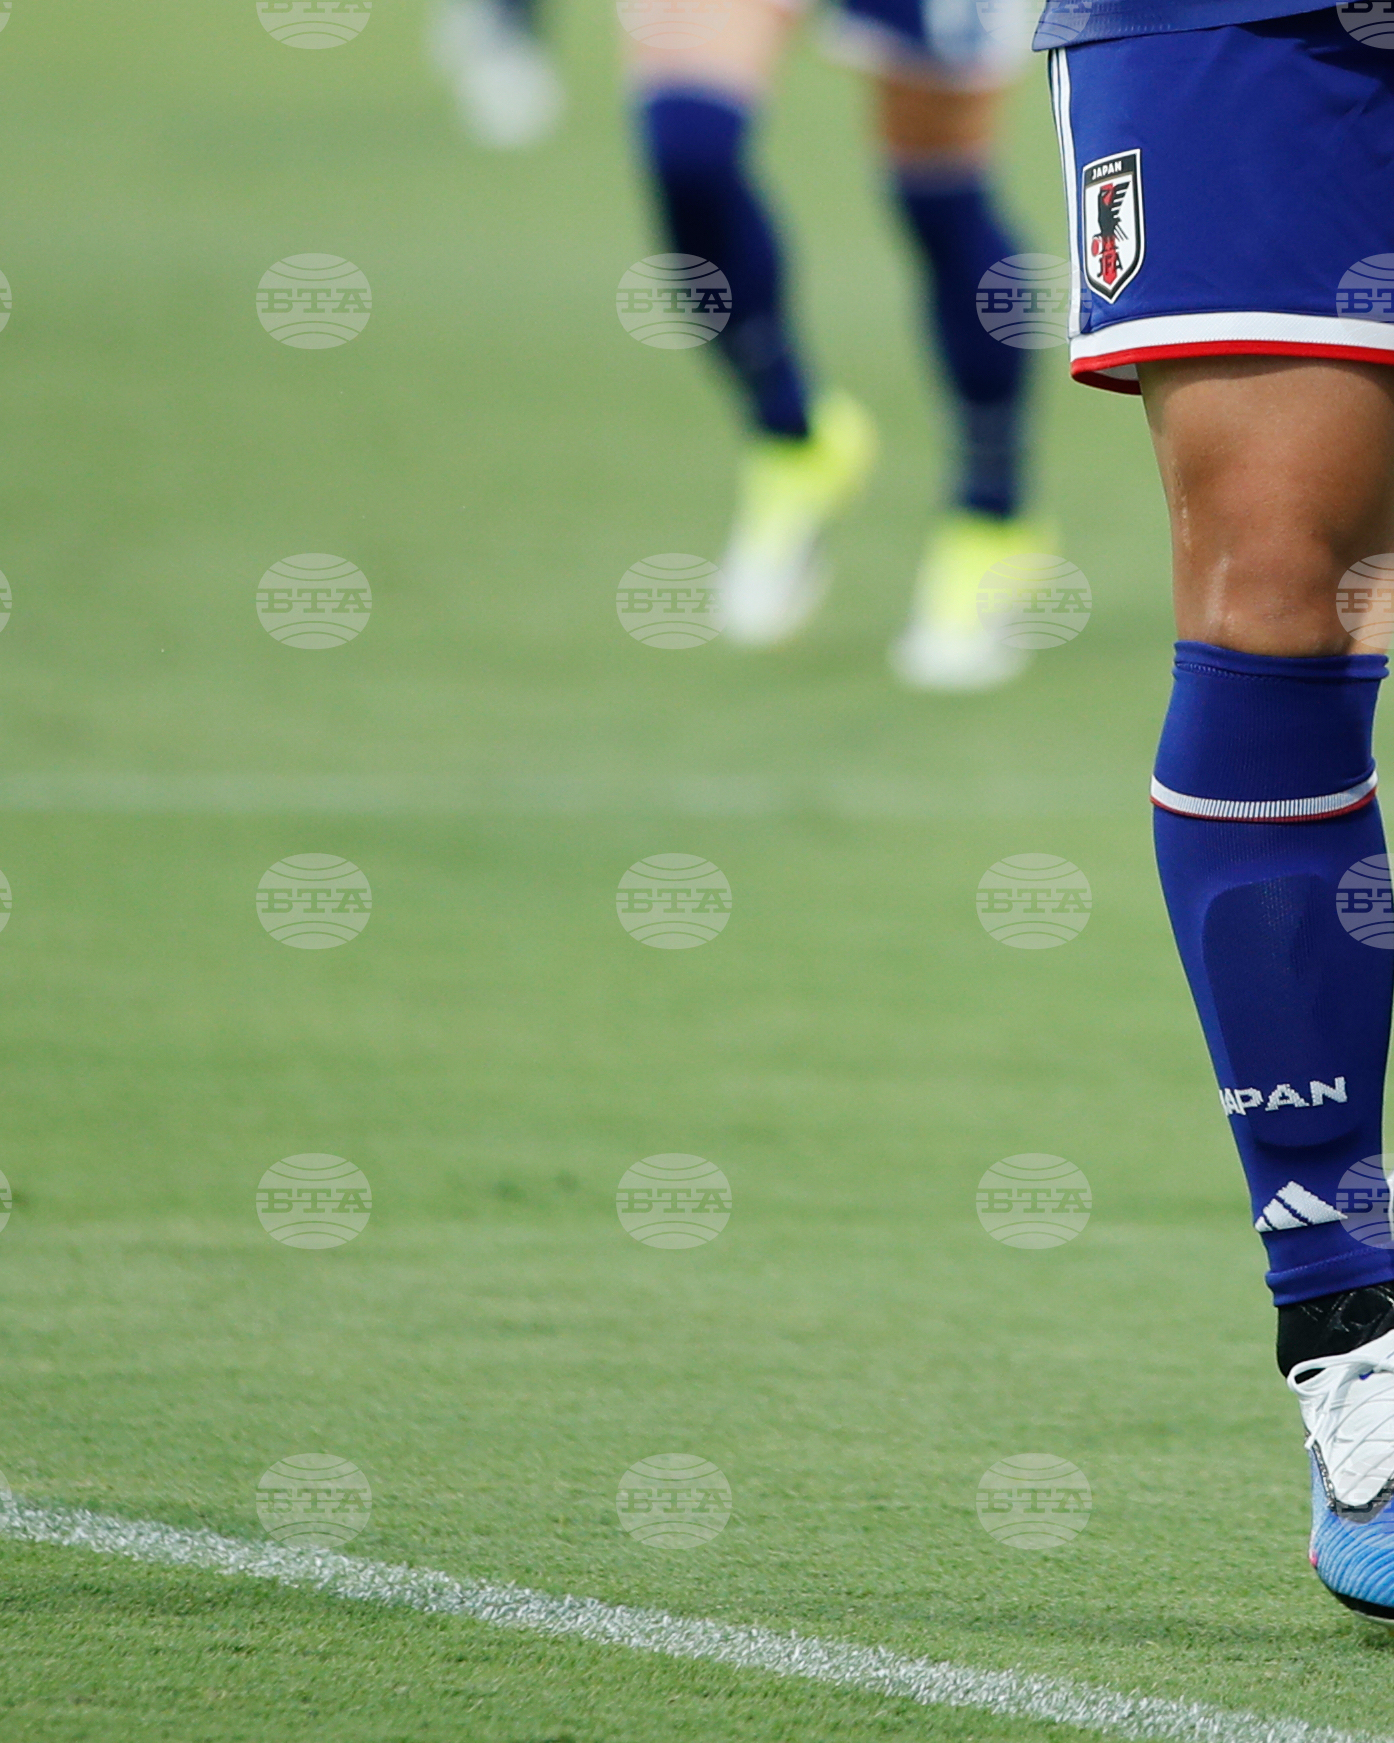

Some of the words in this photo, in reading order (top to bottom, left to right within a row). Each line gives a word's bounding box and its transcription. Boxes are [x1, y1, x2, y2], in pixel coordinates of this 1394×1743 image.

[1092, 161, 1122, 180] JAPAN
[1097, 252, 1123, 278] JFA
[1219, 1076, 1348, 1116] APAN
